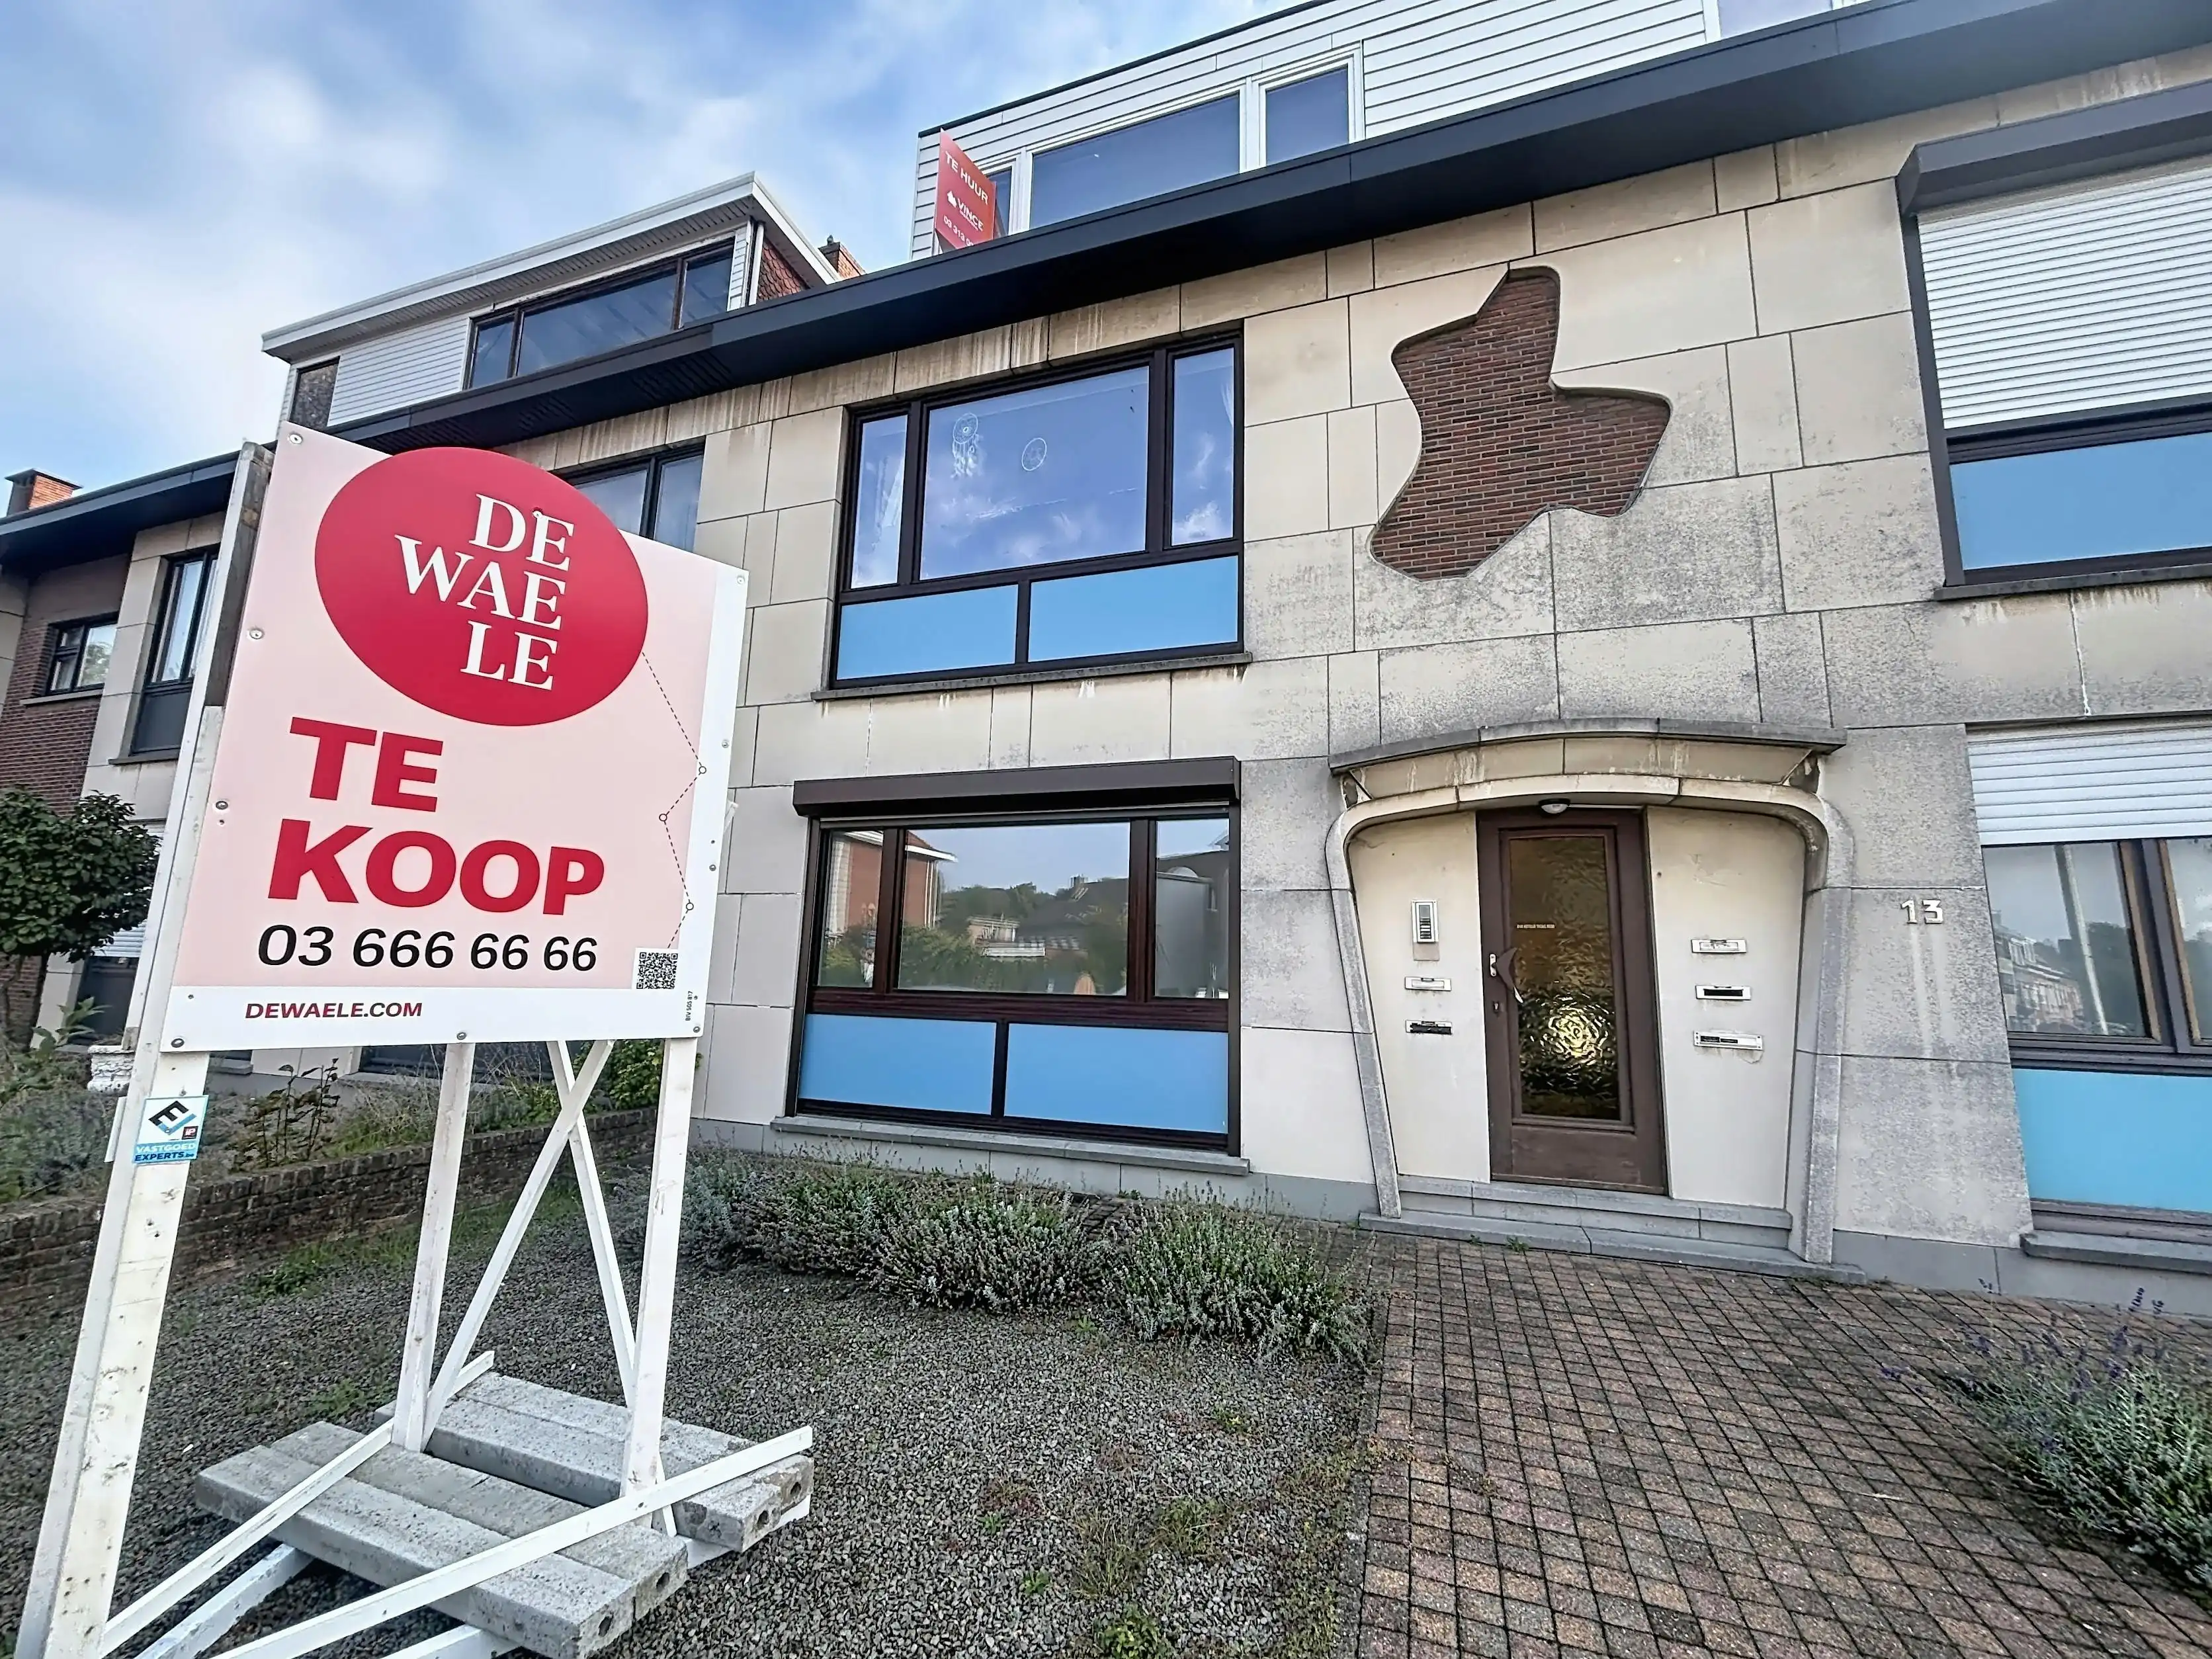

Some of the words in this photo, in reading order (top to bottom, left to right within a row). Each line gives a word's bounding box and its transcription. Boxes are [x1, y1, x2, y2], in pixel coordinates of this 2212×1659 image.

[945, 151, 958, 172] TE
[960, 168, 988, 206] HUUR
[957, 197, 984, 232] VINCE
[469, 493, 575, 572] DE
[394, 534, 566, 631] WAE
[460, 620, 560, 691] LE
[289, 716, 444, 813] TE
[267, 818, 605, 916] KOOP
[1900, 899, 1943, 924] 13
[257, 925, 333, 967] 03
[353, 928, 454, 969] 666
[470, 932, 530, 970] 66
[544, 936, 597, 972] 66
[245, 1002, 423, 1019] DEWAELE.COM
[136, 1143, 195, 1153] VASTGOED
